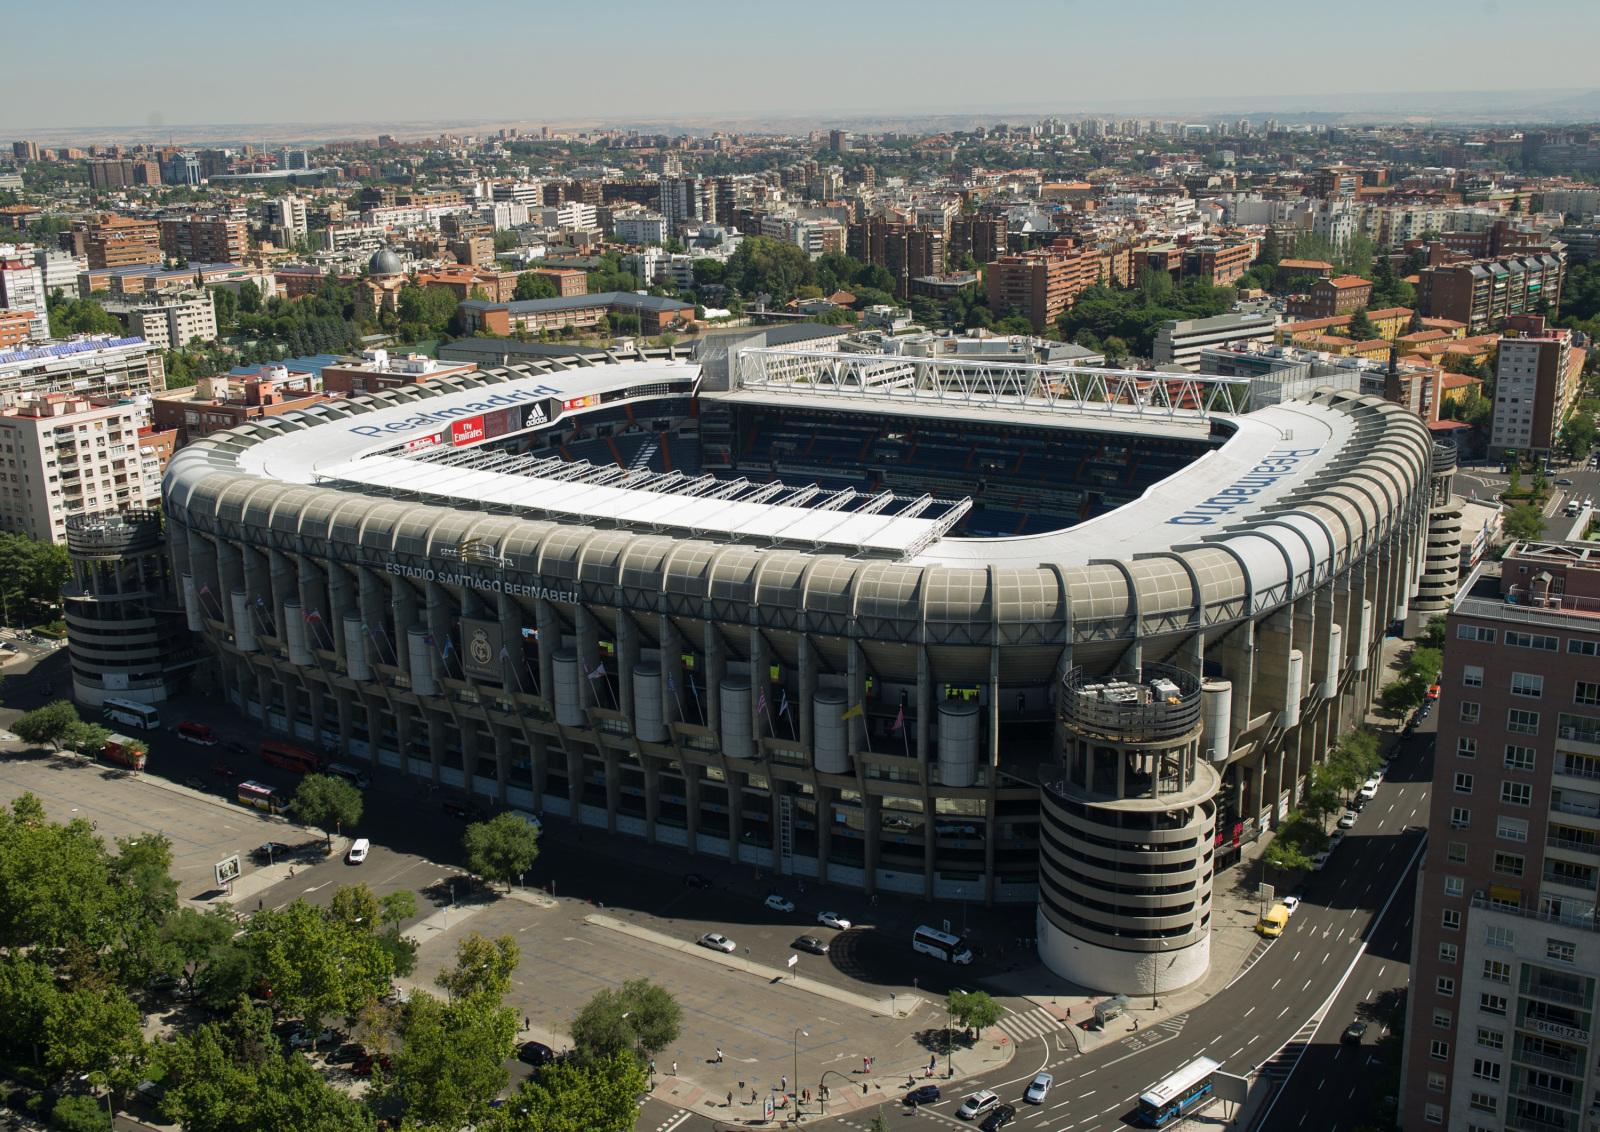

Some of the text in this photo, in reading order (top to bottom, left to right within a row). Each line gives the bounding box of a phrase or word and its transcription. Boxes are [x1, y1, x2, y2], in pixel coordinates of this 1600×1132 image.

[525, 416, 548, 428] adidas
[454, 428, 483, 443] Emirates
[385, 562, 578, 605] ESTADIO SANTIAGO BERNABEU
